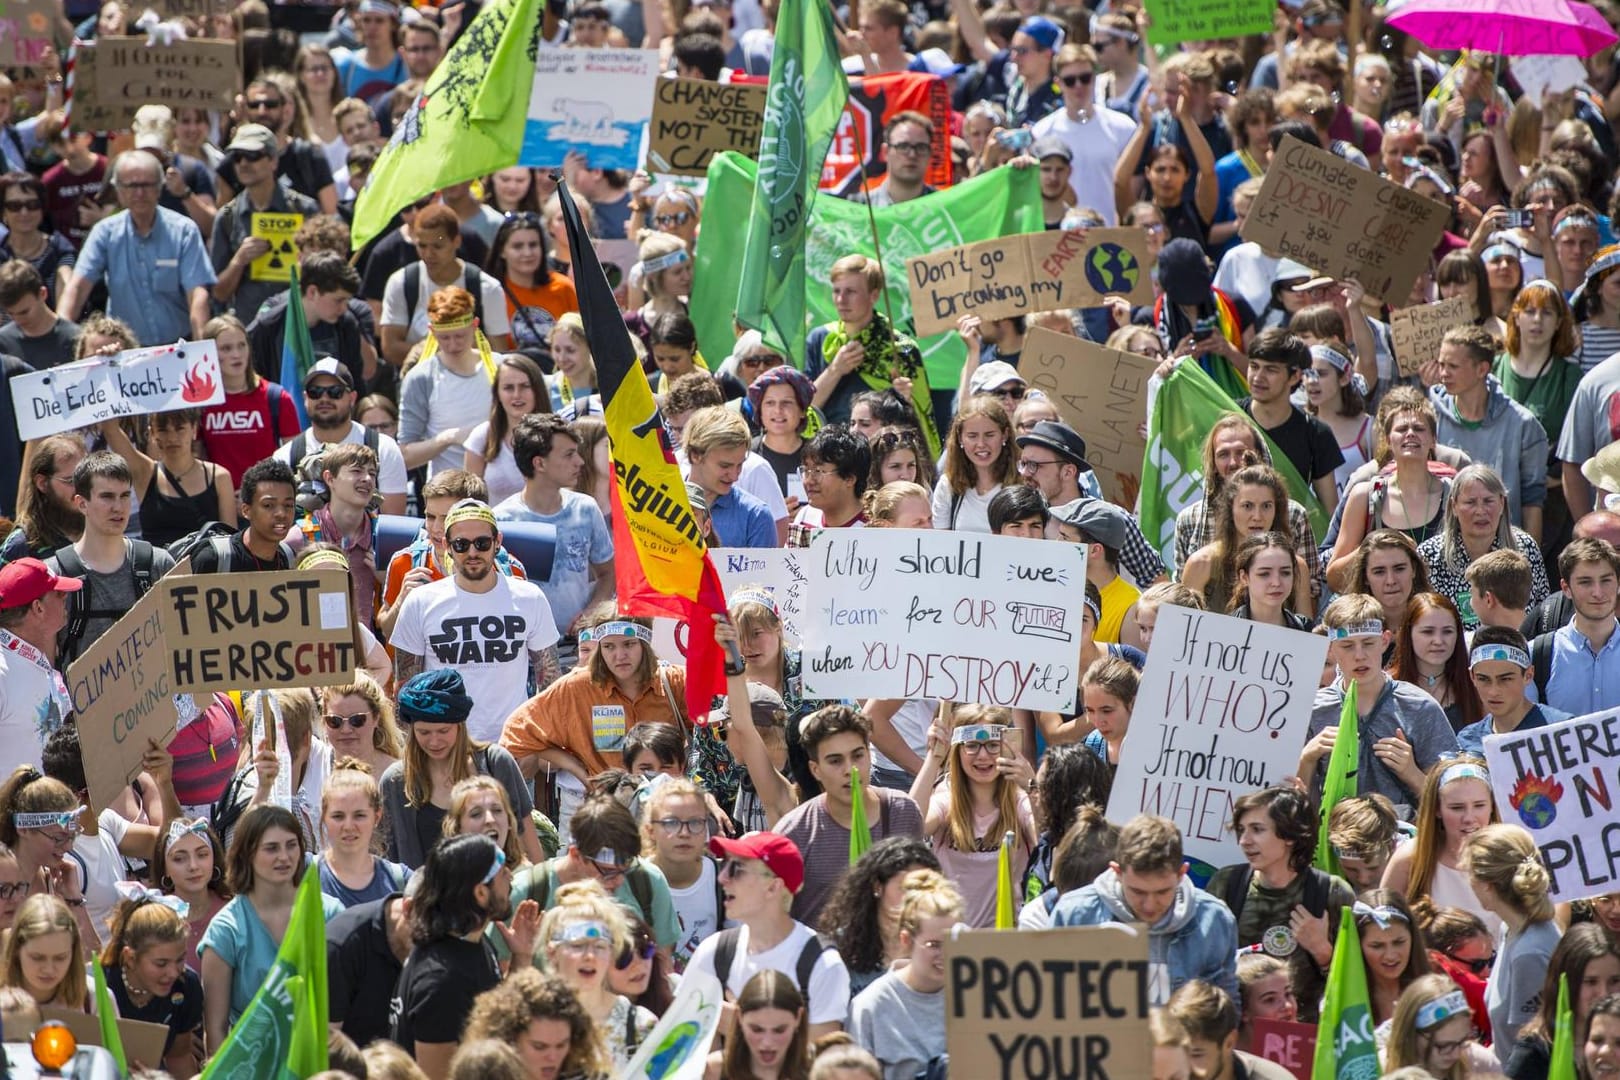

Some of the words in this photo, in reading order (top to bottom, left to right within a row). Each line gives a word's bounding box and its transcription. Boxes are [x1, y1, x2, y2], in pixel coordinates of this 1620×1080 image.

[659, 80, 749, 109] CHANGE
[658, 120, 708, 141] NOT
[258, 217, 297, 230] STOP
[1364, 215, 1416, 248] CARE
[912, 249, 973, 289] Don't
[980, 249, 1005, 280] go
[1042, 228, 1091, 279] EARTH
[1279, 232, 1329, 270] believe
[931, 283, 1028, 320] breaking
[1030, 279, 1064, 302] my
[32, 396, 61, 421] Die
[65, 381, 106, 411] Erde
[92, 409, 110, 420] vor
[205, 410, 264, 430] NASA
[1061, 394, 1089, 413] A
[1087, 352, 1145, 472] PLANET
[614, 458, 705, 550] elgium
[643, 540, 679, 556] LGIUM
[727, 554, 766, 573] Klima
[825, 538, 878, 592] Why
[895, 537, 981, 579] should
[1017, 564, 1057, 582] we
[170, 579, 321, 636] FRUST
[786, 583, 800, 599] for
[428, 615, 527, 645] STOP
[905, 594, 943, 633] for
[953, 597, 997, 630] OUR
[1017, 605, 1065, 629] FUTURE
[73, 608, 164, 716] CLIMATECH
[173, 640, 354, 687] HERRSCHT
[431, 639, 525, 665] WARS
[1174, 613, 1205, 666] If
[1205, 624, 1252, 675] not
[1261, 649, 1294, 688] us,
[131, 662, 145, 691] IS
[812, 644, 854, 674] when
[861, 641, 900, 672] YOU
[904, 652, 1036, 707] DESTROY
[1031, 662, 1070, 695] it?
[112, 673, 169, 744] COMING
[1165, 670, 1291, 739] WHO?
[1144, 724, 1179, 777] If
[1177, 734, 1219, 780] not
[1219, 754, 1271, 789] now,
[1500, 716, 1620, 781] THERE
[1572, 766, 1620, 819] N
[951, 955, 1149, 1020] PROTECT
[987, 1032, 1111, 1080] YOUR
